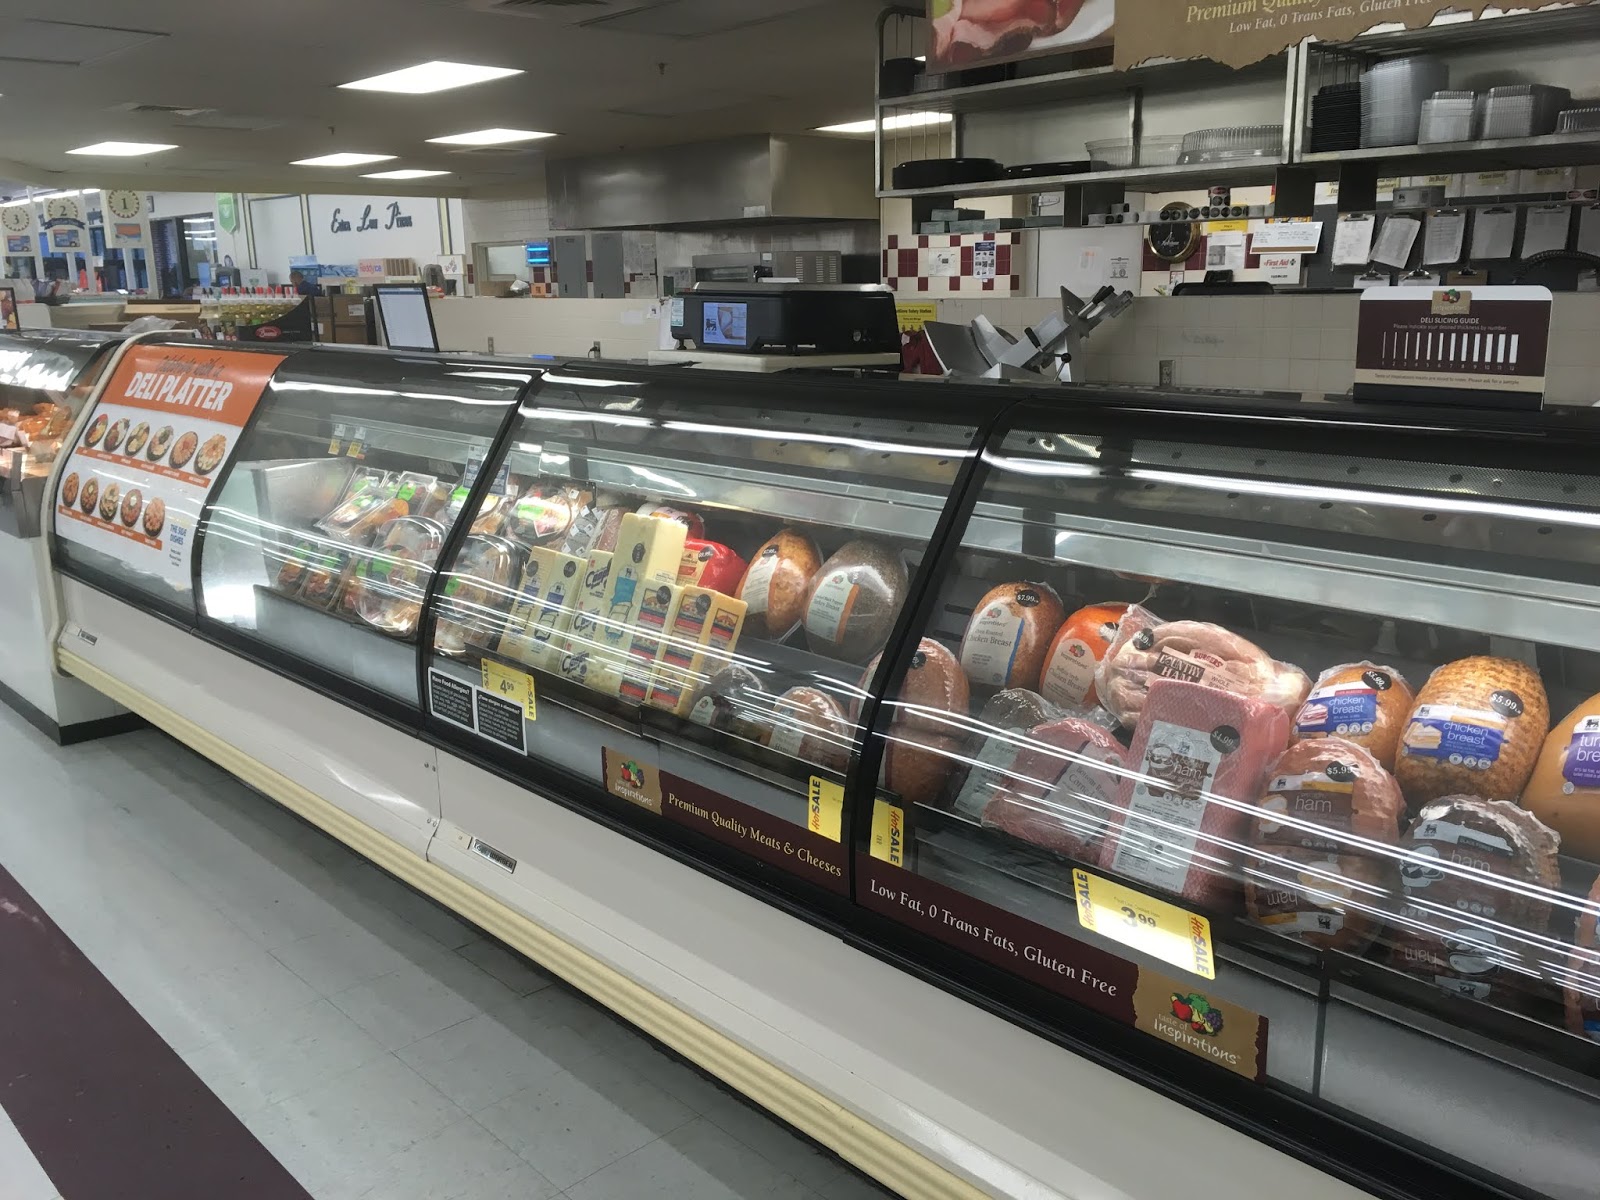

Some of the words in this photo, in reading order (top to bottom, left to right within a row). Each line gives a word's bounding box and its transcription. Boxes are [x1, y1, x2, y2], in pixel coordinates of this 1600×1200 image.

[1186, 0, 1259, 23] Premium
[1229, 21, 1253, 34] Low
[1255, 16, 1277, 30] Fat,
[1280, 14, 1288, 26] 0
[1291, 9, 1324, 24] Trans
[1326, 5, 1356, 20] Fats,
[1359, 0, 1402, 14] Gluten
[59, 205, 68, 217] 2
[121, 197, 128, 210] 1
[13, 214, 20, 225] 3
[1266, 259, 1280, 267] First
[1281, 259, 1289, 267] Aid
[124, 372, 162, 401] DELI
[157, 374, 234, 412] PLATTER
[1016, 594, 1036, 603] $7.99
[967, 635, 989, 644] Chicken
[989, 637, 1012, 647] Breast
[1159, 654, 1202, 677] COUNTRY
[442, 679, 451, 688] Food
[1328, 697, 1365, 706] chicken
[1332, 705, 1364, 715] breast
[1443, 722, 1489, 737] chicken
[1447, 732, 1486, 746] breast
[1173, 762, 1203, 778] ham
[1295, 795, 1332, 812] ham
[668, 792, 709, 820] Premium
[711, 811, 748, 839] Quality
[750, 826, 781, 851] Meats
[783, 841, 795, 855] &
[797, 847, 842, 877] Cheeses
[1452, 850, 1491, 873] ham
[870, 879, 896, 901] Low
[899, 891, 925, 917] Fat,
[929, 905, 938, 918] 0
[942, 909, 980, 937] Trans
[983, 927, 1019, 957] Fats,
[1024, 946, 1076, 980] Gluten
[1080, 968, 1117, 997] Free
[1153, 1018, 1237, 1065] Inspirations
